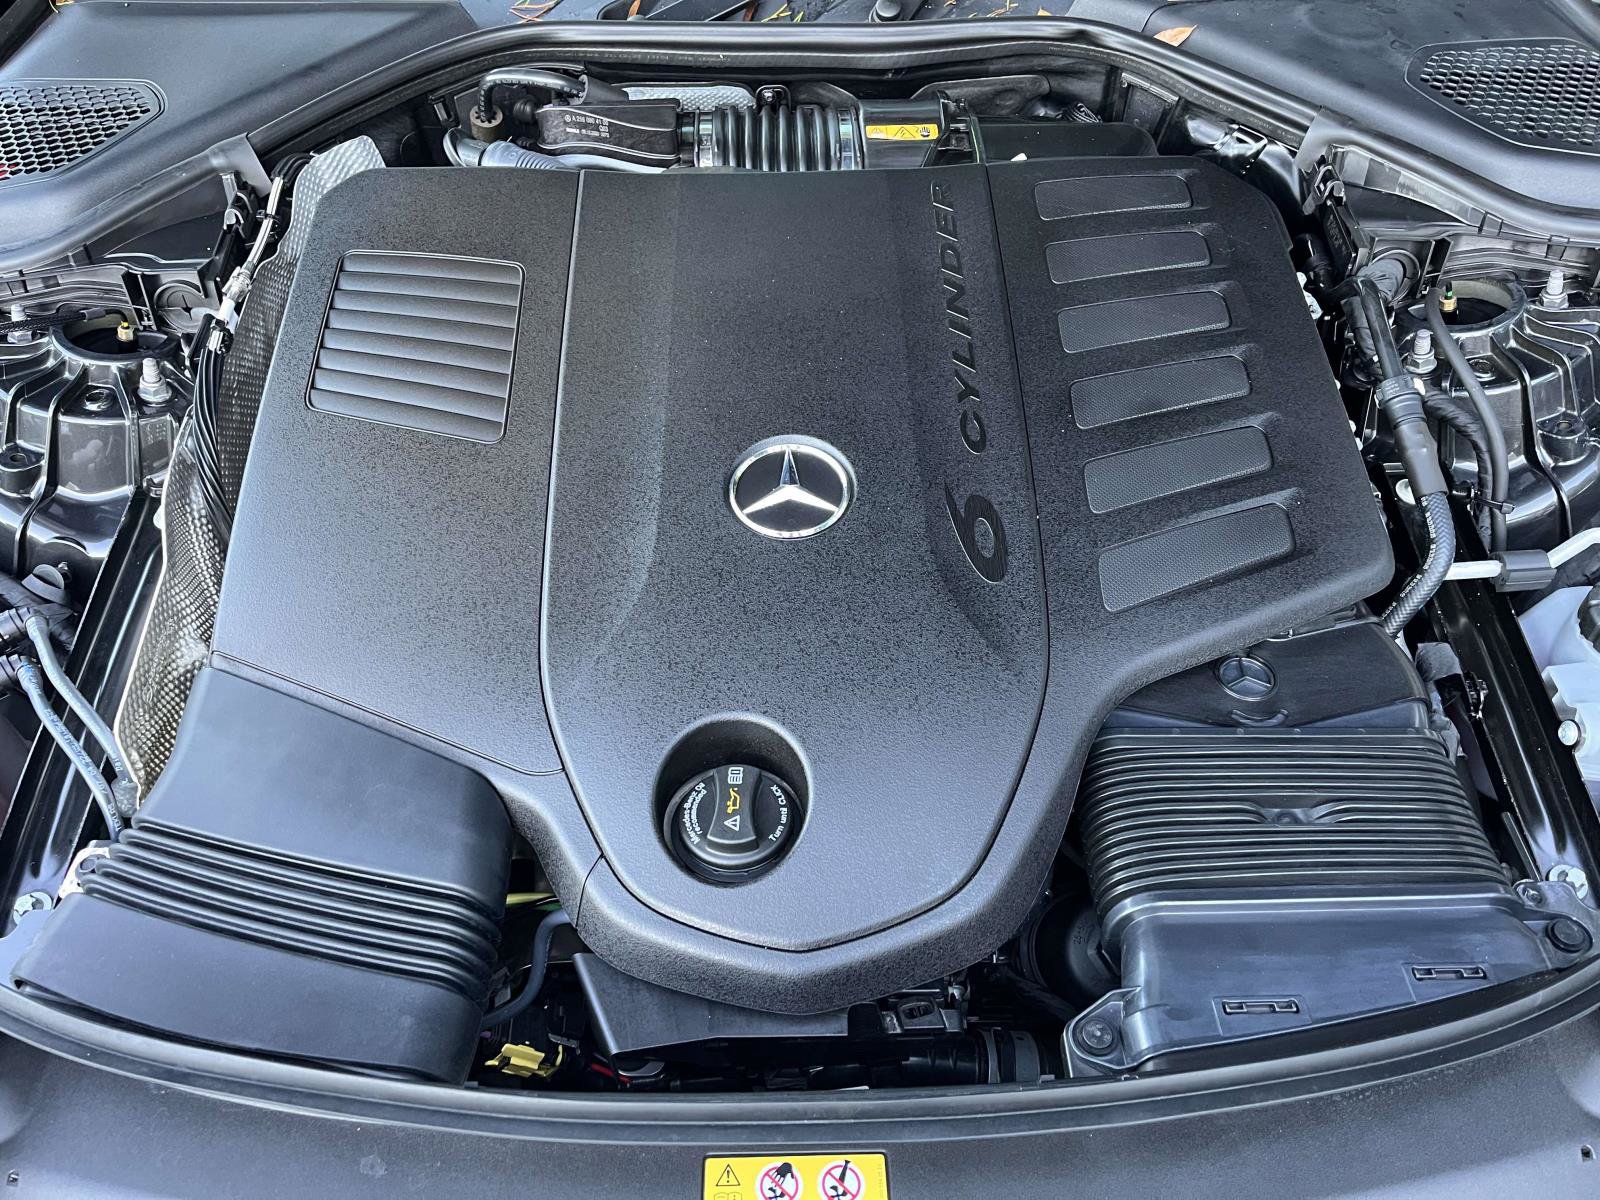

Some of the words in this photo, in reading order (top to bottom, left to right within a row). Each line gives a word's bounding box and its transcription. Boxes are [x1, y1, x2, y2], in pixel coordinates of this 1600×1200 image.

[930, 181, 986, 455] CYLINDER
[944, 480, 1008, 583] 6
[682, 790, 701, 844] Mercedes-Benz
[690, 789, 707, 835] recommended
[770, 784, 787, 805] CLICK
[768, 825, 785, 842] Turn
